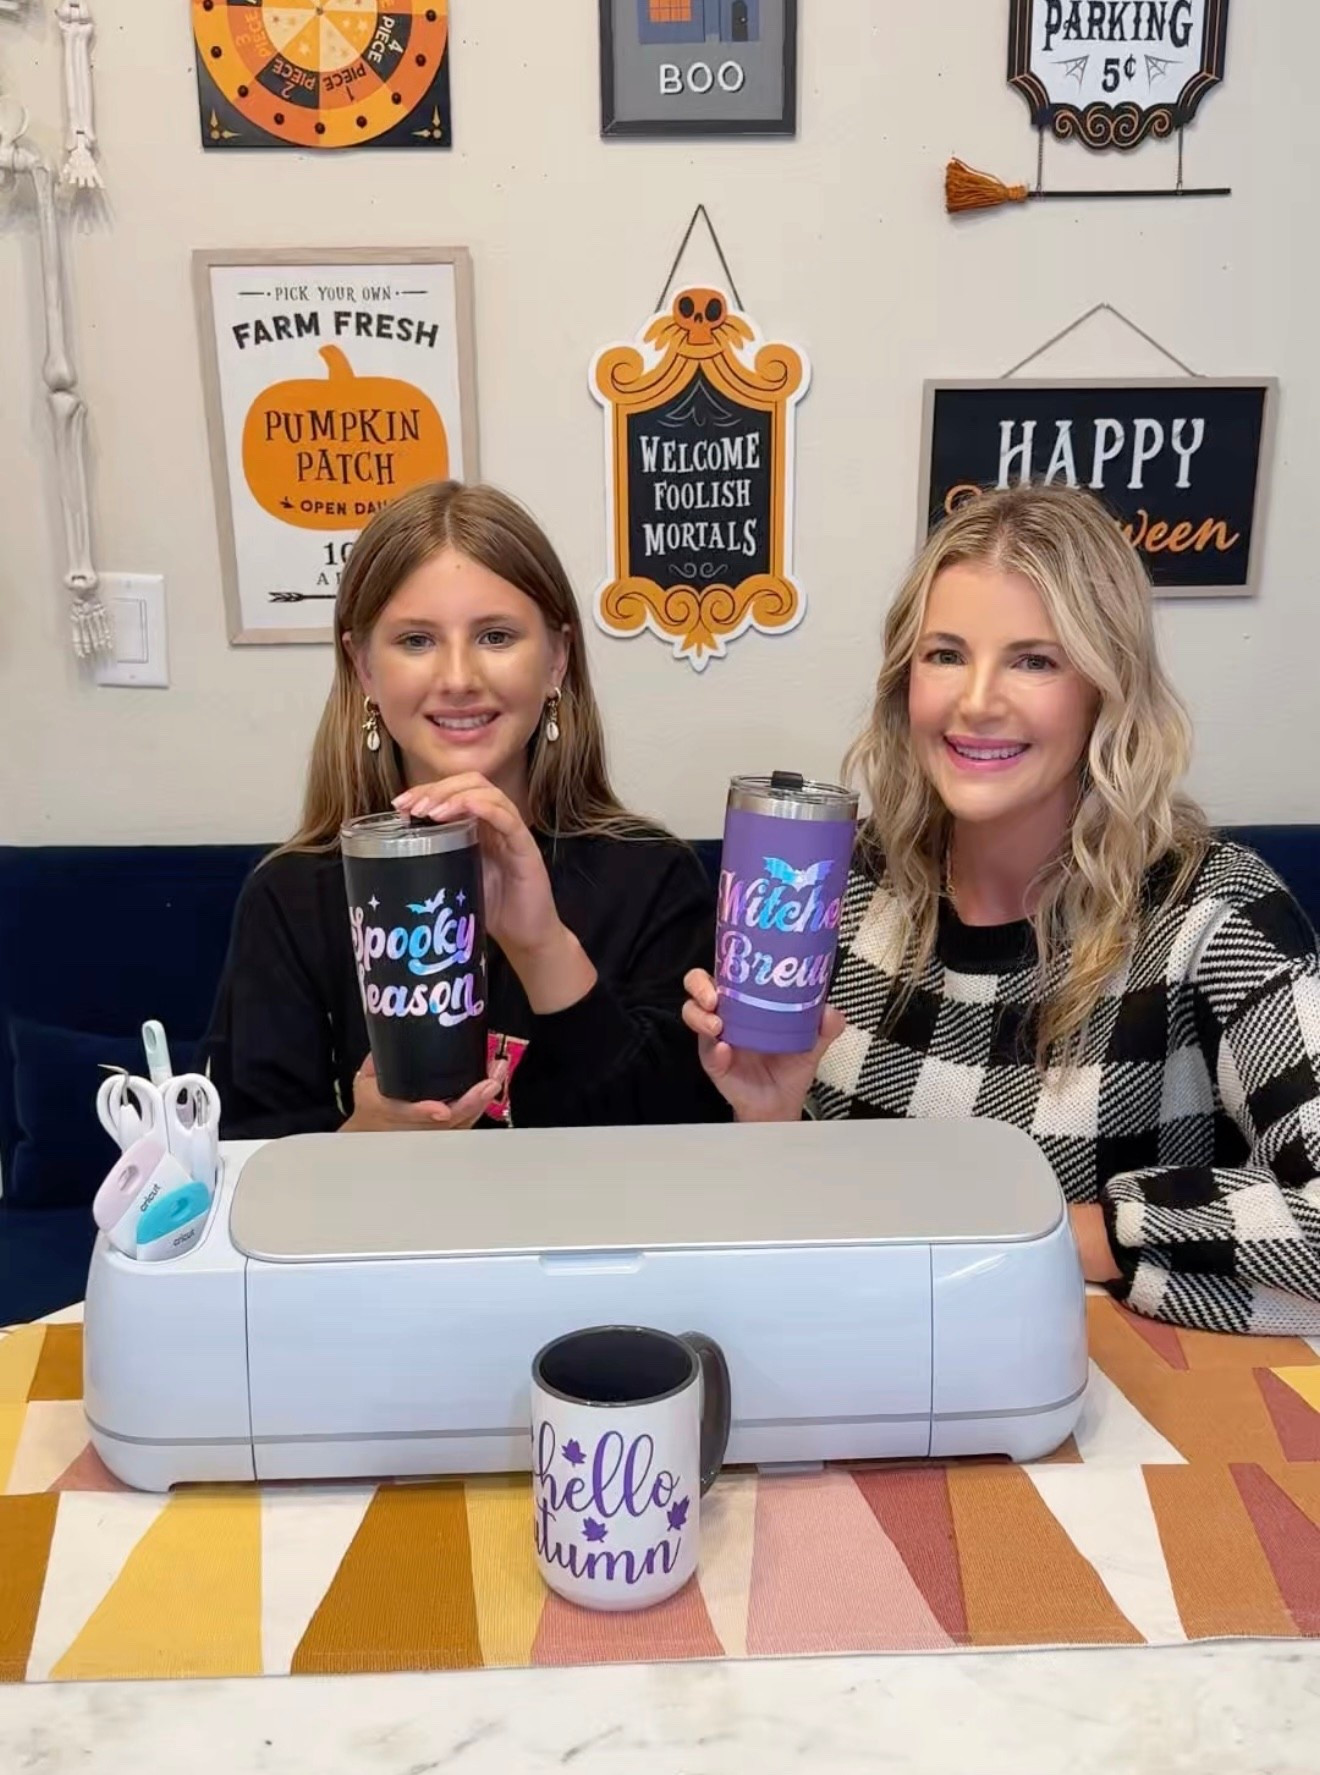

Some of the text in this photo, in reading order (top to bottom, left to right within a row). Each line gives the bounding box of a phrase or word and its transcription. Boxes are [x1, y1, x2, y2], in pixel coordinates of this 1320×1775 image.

[367, 15, 396, 64] PIECE
[1042, 0, 1194, 51] PARKING
[388, 39, 404, 54] 4
[272, 58, 317, 90] PIECE
[281, 82, 295, 99] 2
[322, 62, 367, 92] PIECE
[659, 60, 745, 95] BOO
[1101, 54, 1137, 93] 5¢
[345, 85, 356, 102] 1
[275, 286, 392, 302] PICK YOUR OWN
[232, 310, 439, 350] FARM FRESH
[264, 408, 421, 444] PUMPKIN
[297, 448, 396, 485] PATCH
[639, 431, 760, 474] WELCOME
[994, 417, 1206, 490] HAPPY
[300, 499, 347, 516] OPEN
[653, 479, 752, 512] FOOLISH
[642, 517, 758, 557] MORTALS
[717, 868, 842, 934] Witche
[349, 906, 476, 976] Spooky
[140, 1183, 161, 1213] cricut
[534, 1420, 681, 1519] hello
